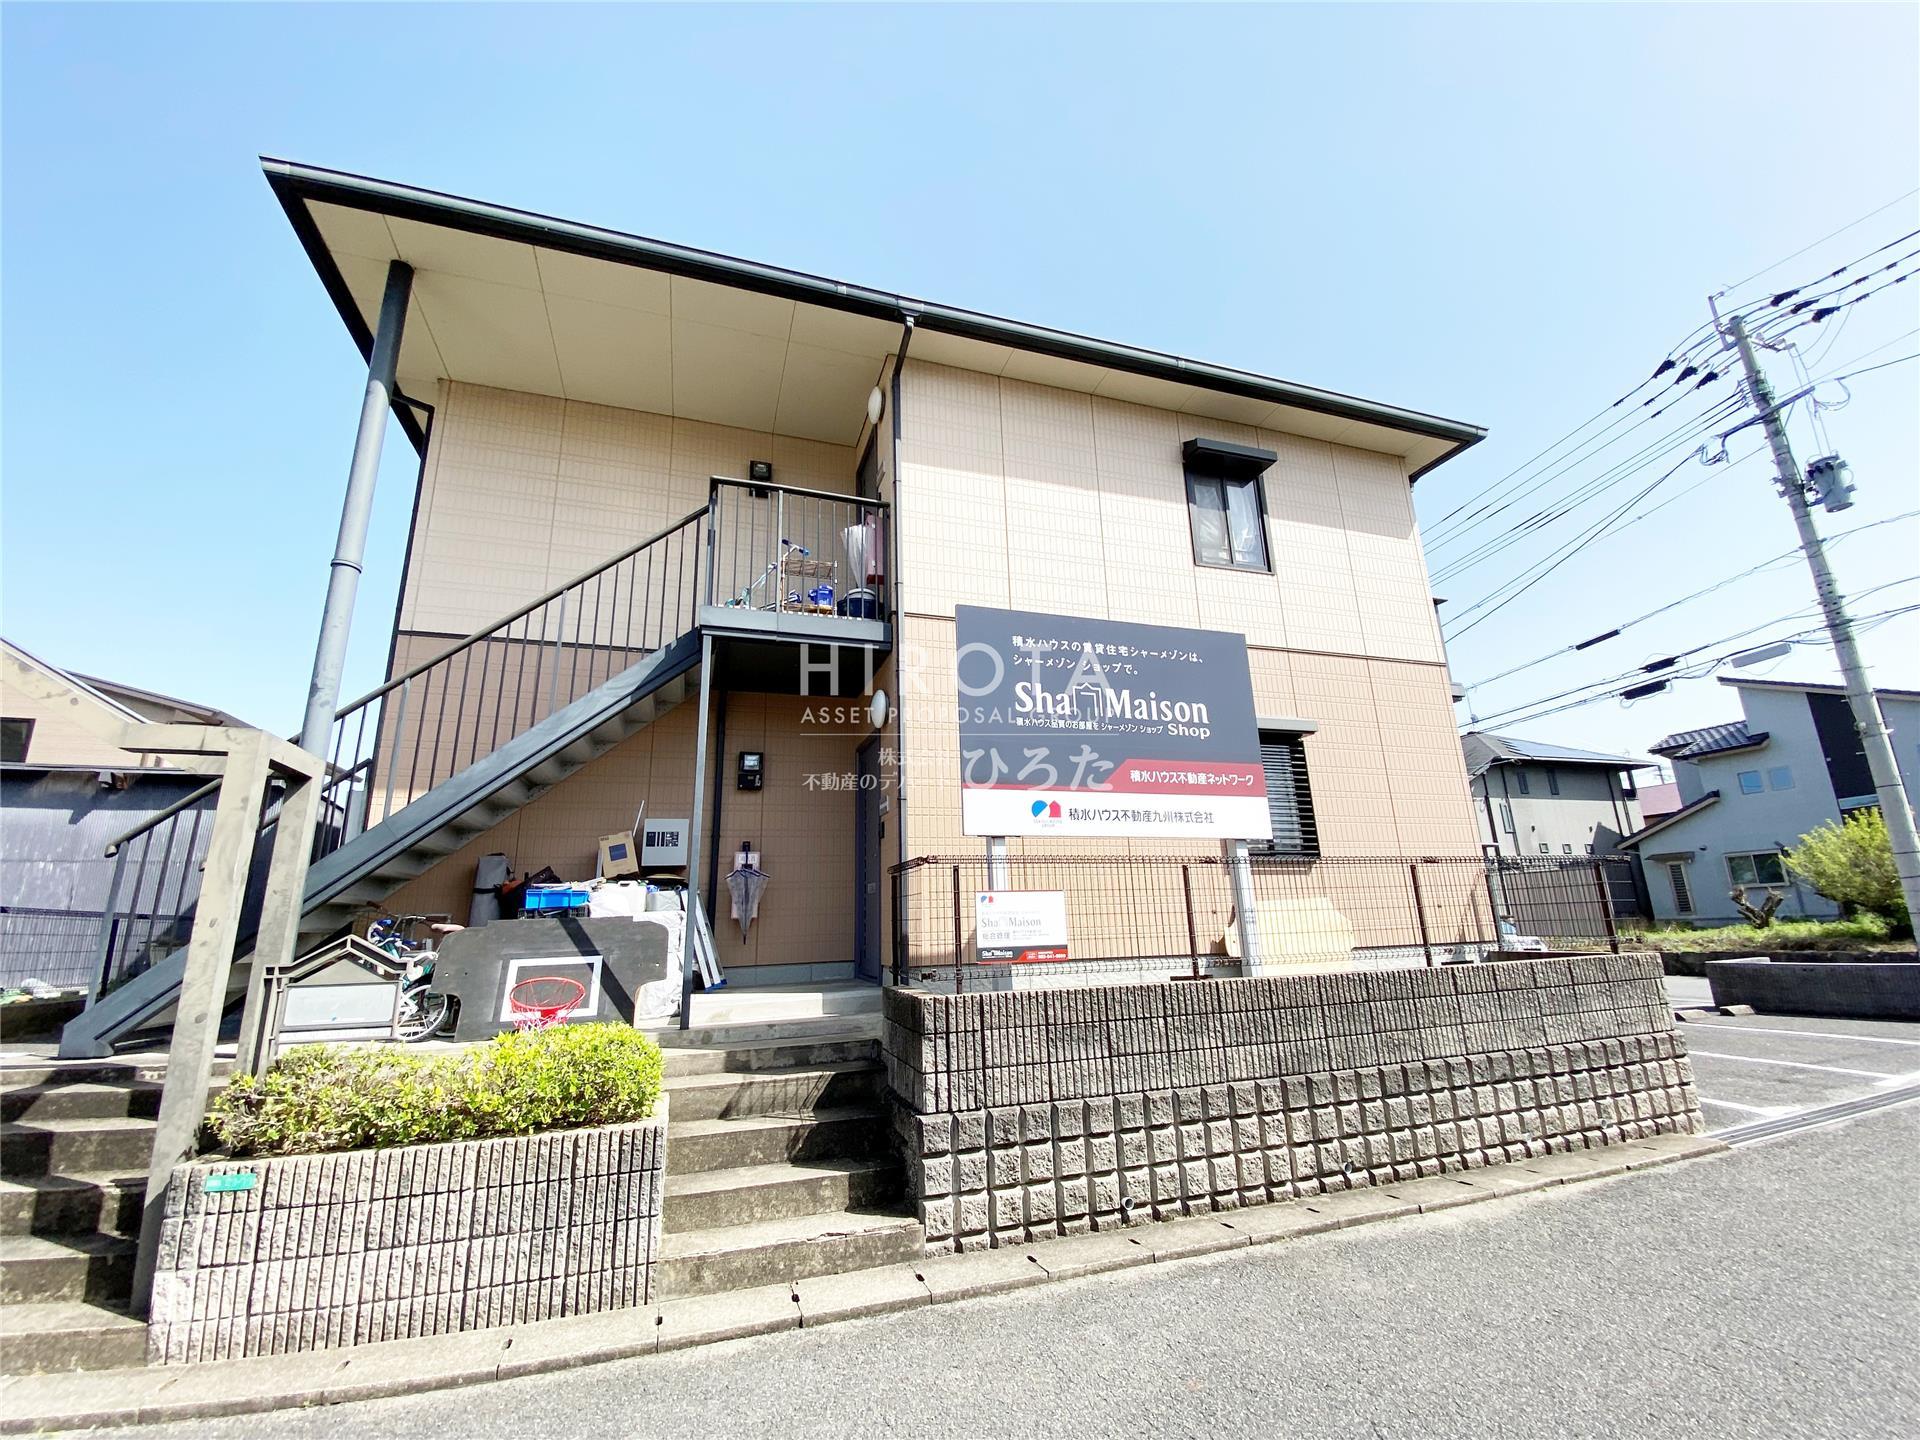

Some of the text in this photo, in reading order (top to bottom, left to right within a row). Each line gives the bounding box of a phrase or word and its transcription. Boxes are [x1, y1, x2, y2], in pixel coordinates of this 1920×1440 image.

[1012, 635, 1204, 663] 積水ハウスの賃貸住宅シャーメゾンは、
[1013, 653, 1139, 675] シャーメゾン ショップで。
[1014, 681, 1210, 724] Sha Maison
[1167, 723, 1211, 739] Shop
[1130, 770, 1254, 786] 積水ハウス不動産ネットワーク
[1068, 807, 1214, 824] 積水ハウス不動産九州株式会社
